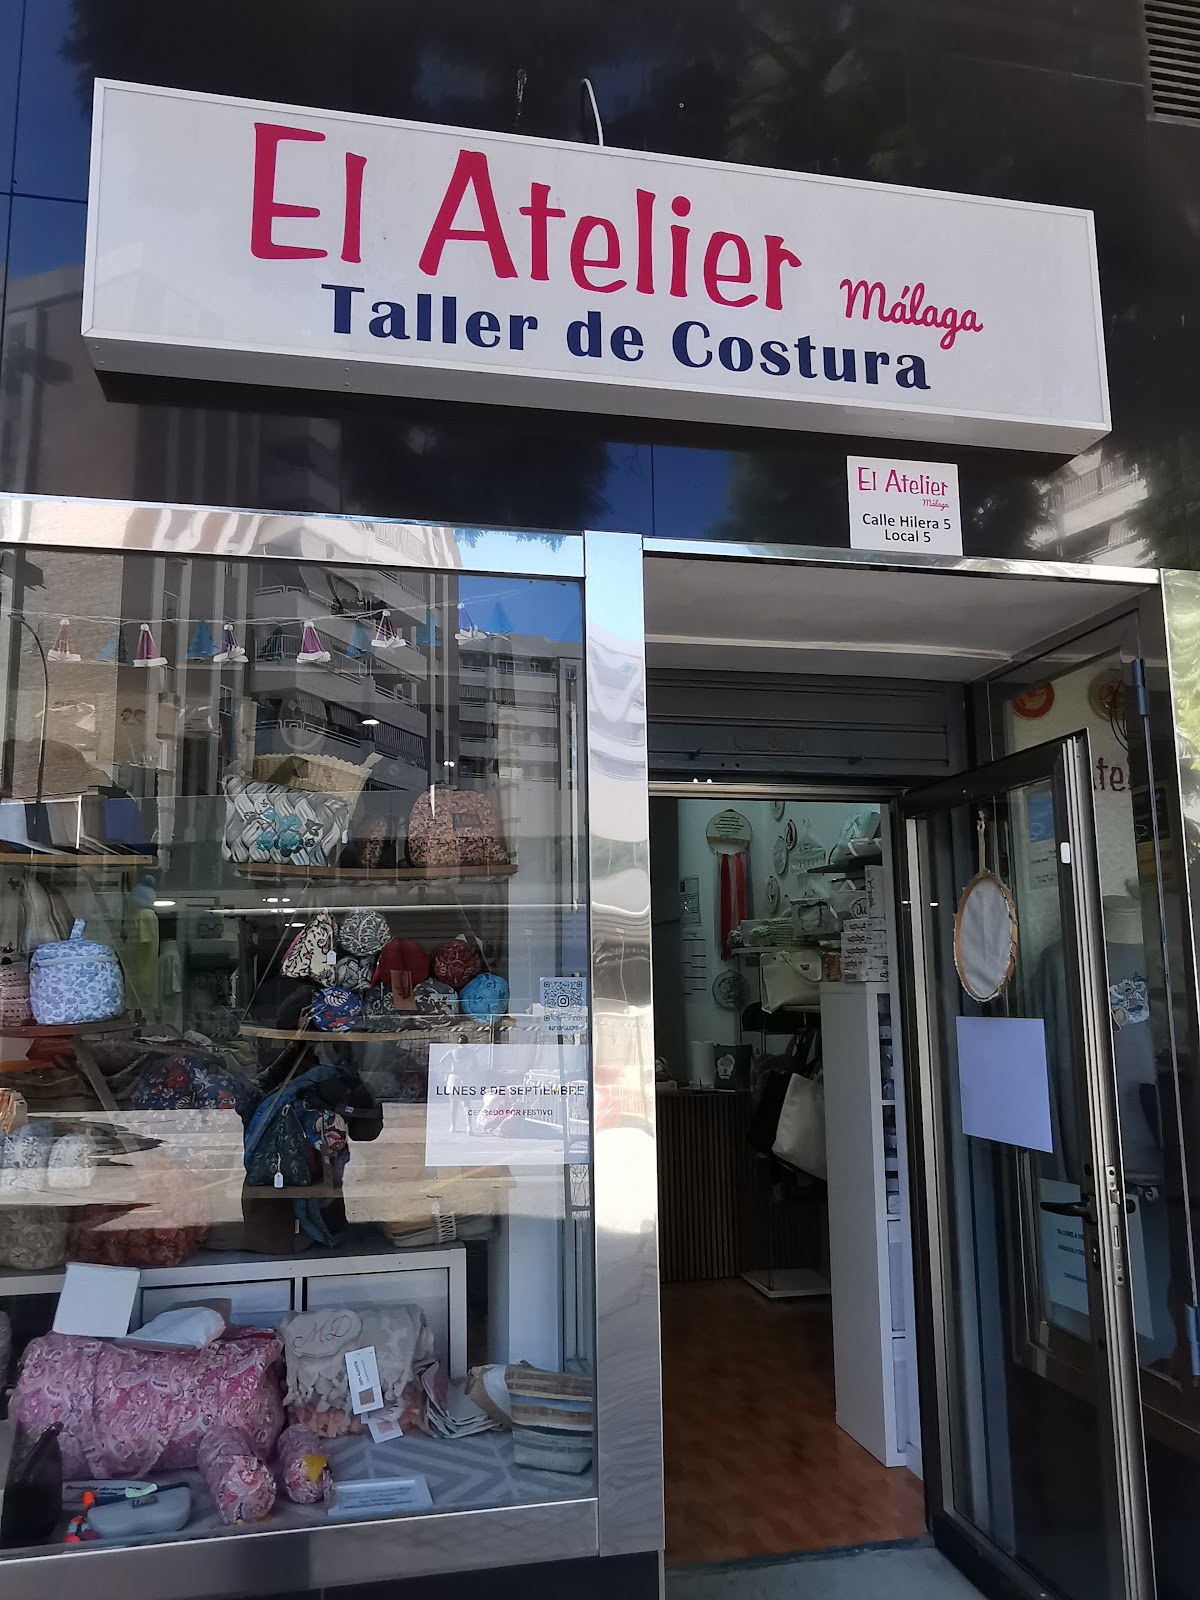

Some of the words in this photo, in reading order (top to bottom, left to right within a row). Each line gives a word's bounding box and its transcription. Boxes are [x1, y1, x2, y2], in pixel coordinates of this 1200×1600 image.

[251, 122, 368, 264] El
[418, 149, 803, 310] Atelier
[839, 278, 984, 350] Málaga
[321, 283, 538, 352] Taller
[566, 310, 645, 362] de
[671, 320, 931, 390] Costura
[857, 466, 877, 492] El
[884, 469, 949, 497] Atelier
[922, 498, 950, 512] Málaga
[862, 513, 896, 527] Calle
[899, 516, 939, 530] Hilera
[943, 519, 951, 530] 5
[884, 529, 919, 543] Local
[923, 531, 931, 543] 5
[436, 1085, 477, 1096] LUNES
[480, 1085, 488, 1096] 8
[490, 1086, 506, 1096] DE
[510, 1085, 585, 1097] SEPTIEMBRE
[467, 1109, 504, 1117] CERADO
[522, 1109, 553, 1117] FESTIVO
